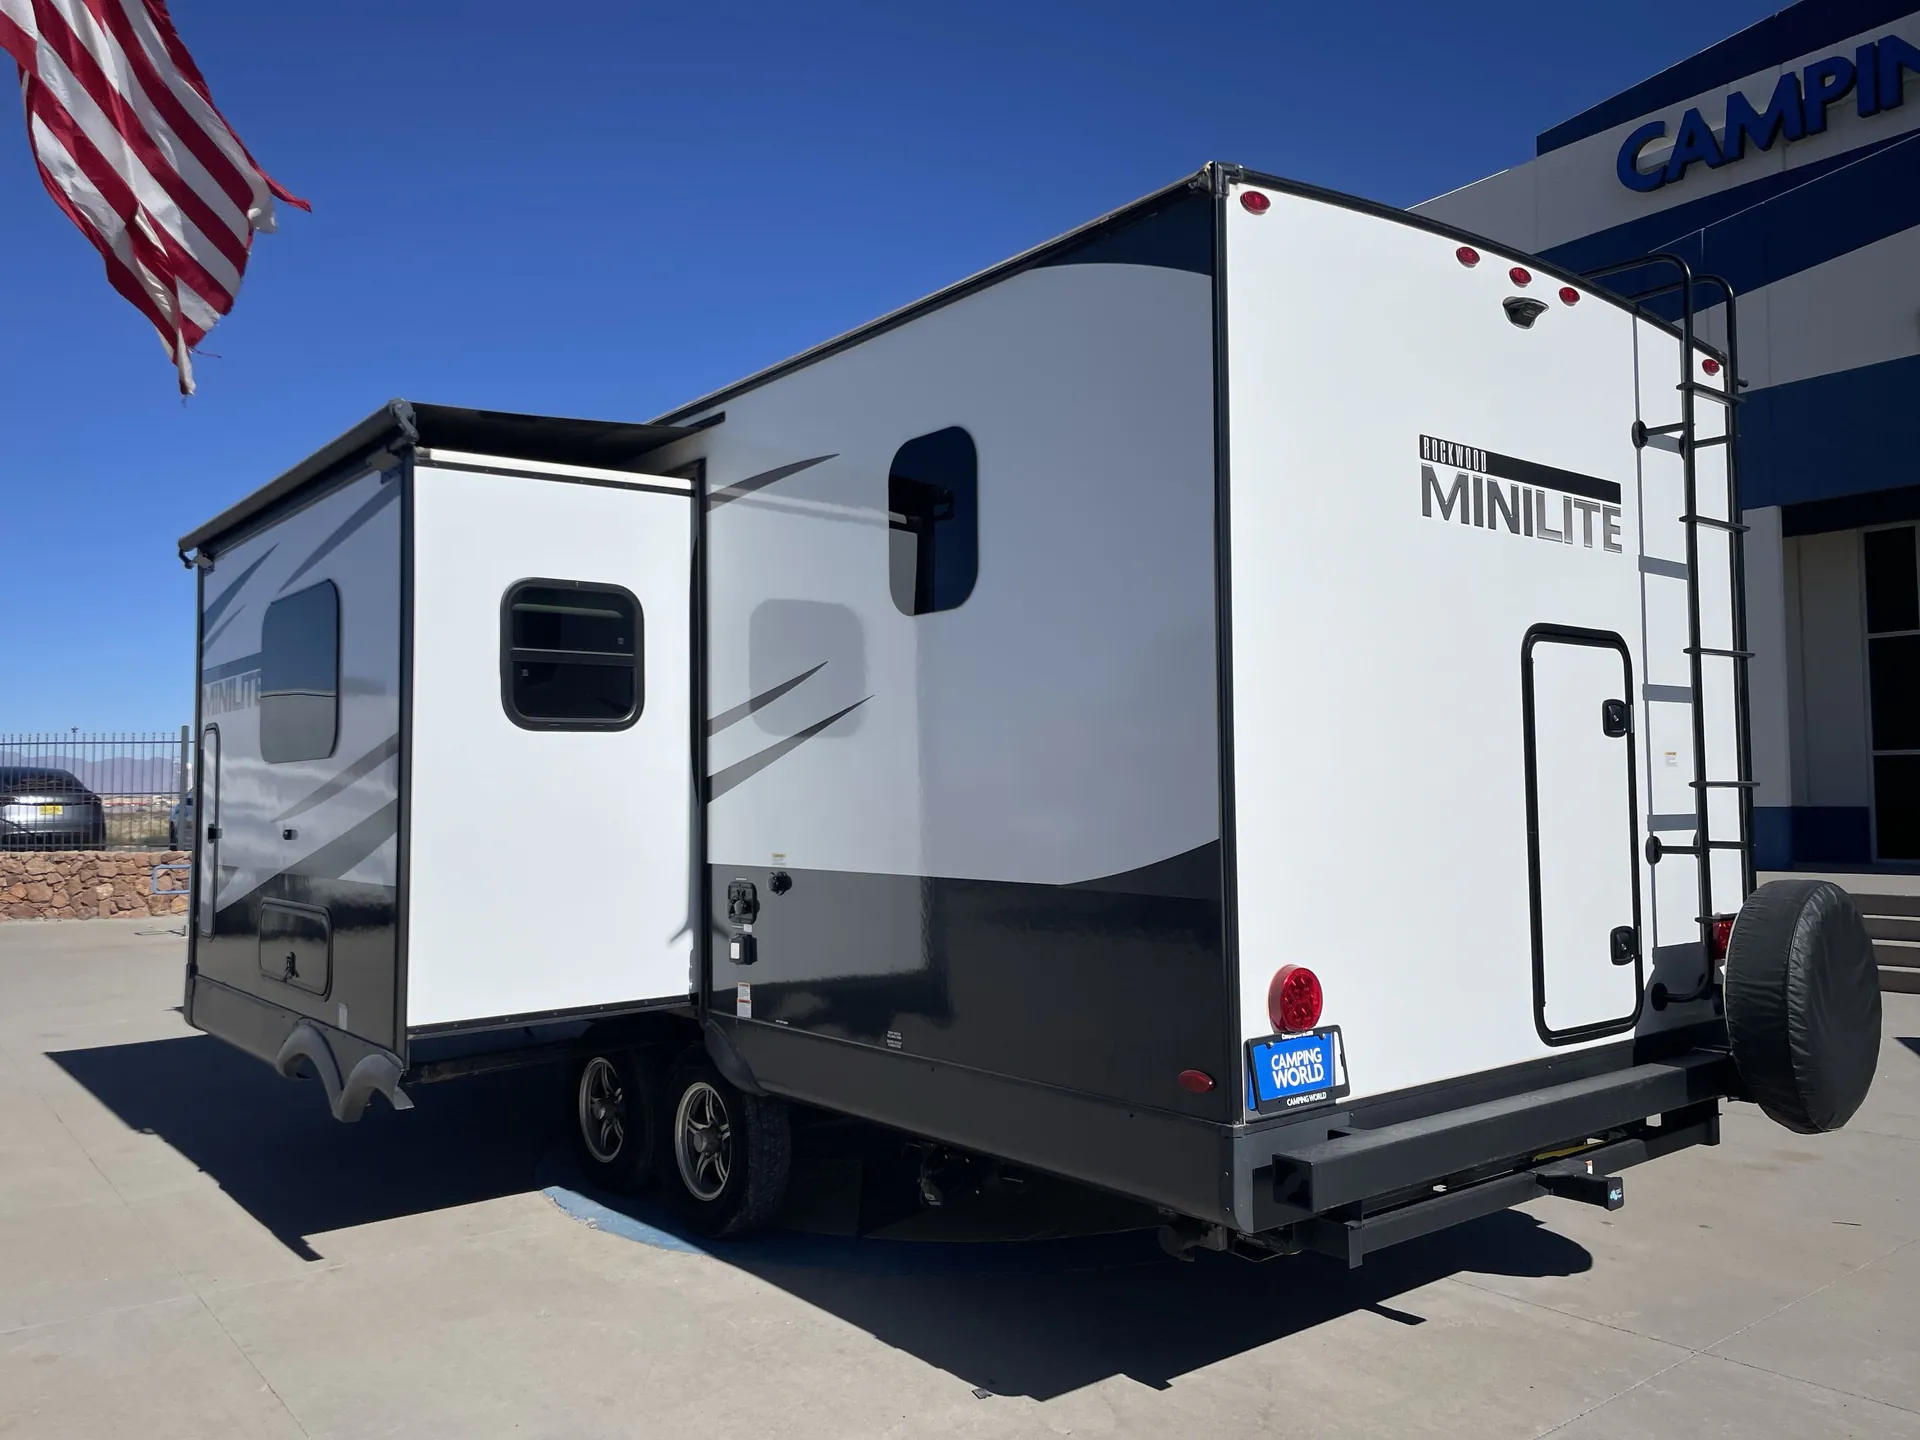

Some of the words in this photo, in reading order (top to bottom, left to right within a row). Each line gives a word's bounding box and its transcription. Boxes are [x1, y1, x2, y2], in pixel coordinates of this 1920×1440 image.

[1423, 436, 1487, 473] ROCKWOOD
[1420, 462, 1623, 554] MINILITE
[1271, 1047, 1323, 1071] CAMPING
[1272, 1063, 1324, 1089] WORLD
[1286, 1094, 1309, 1106] CAMPING
[1308, 1091, 1327, 1103] WORLD
